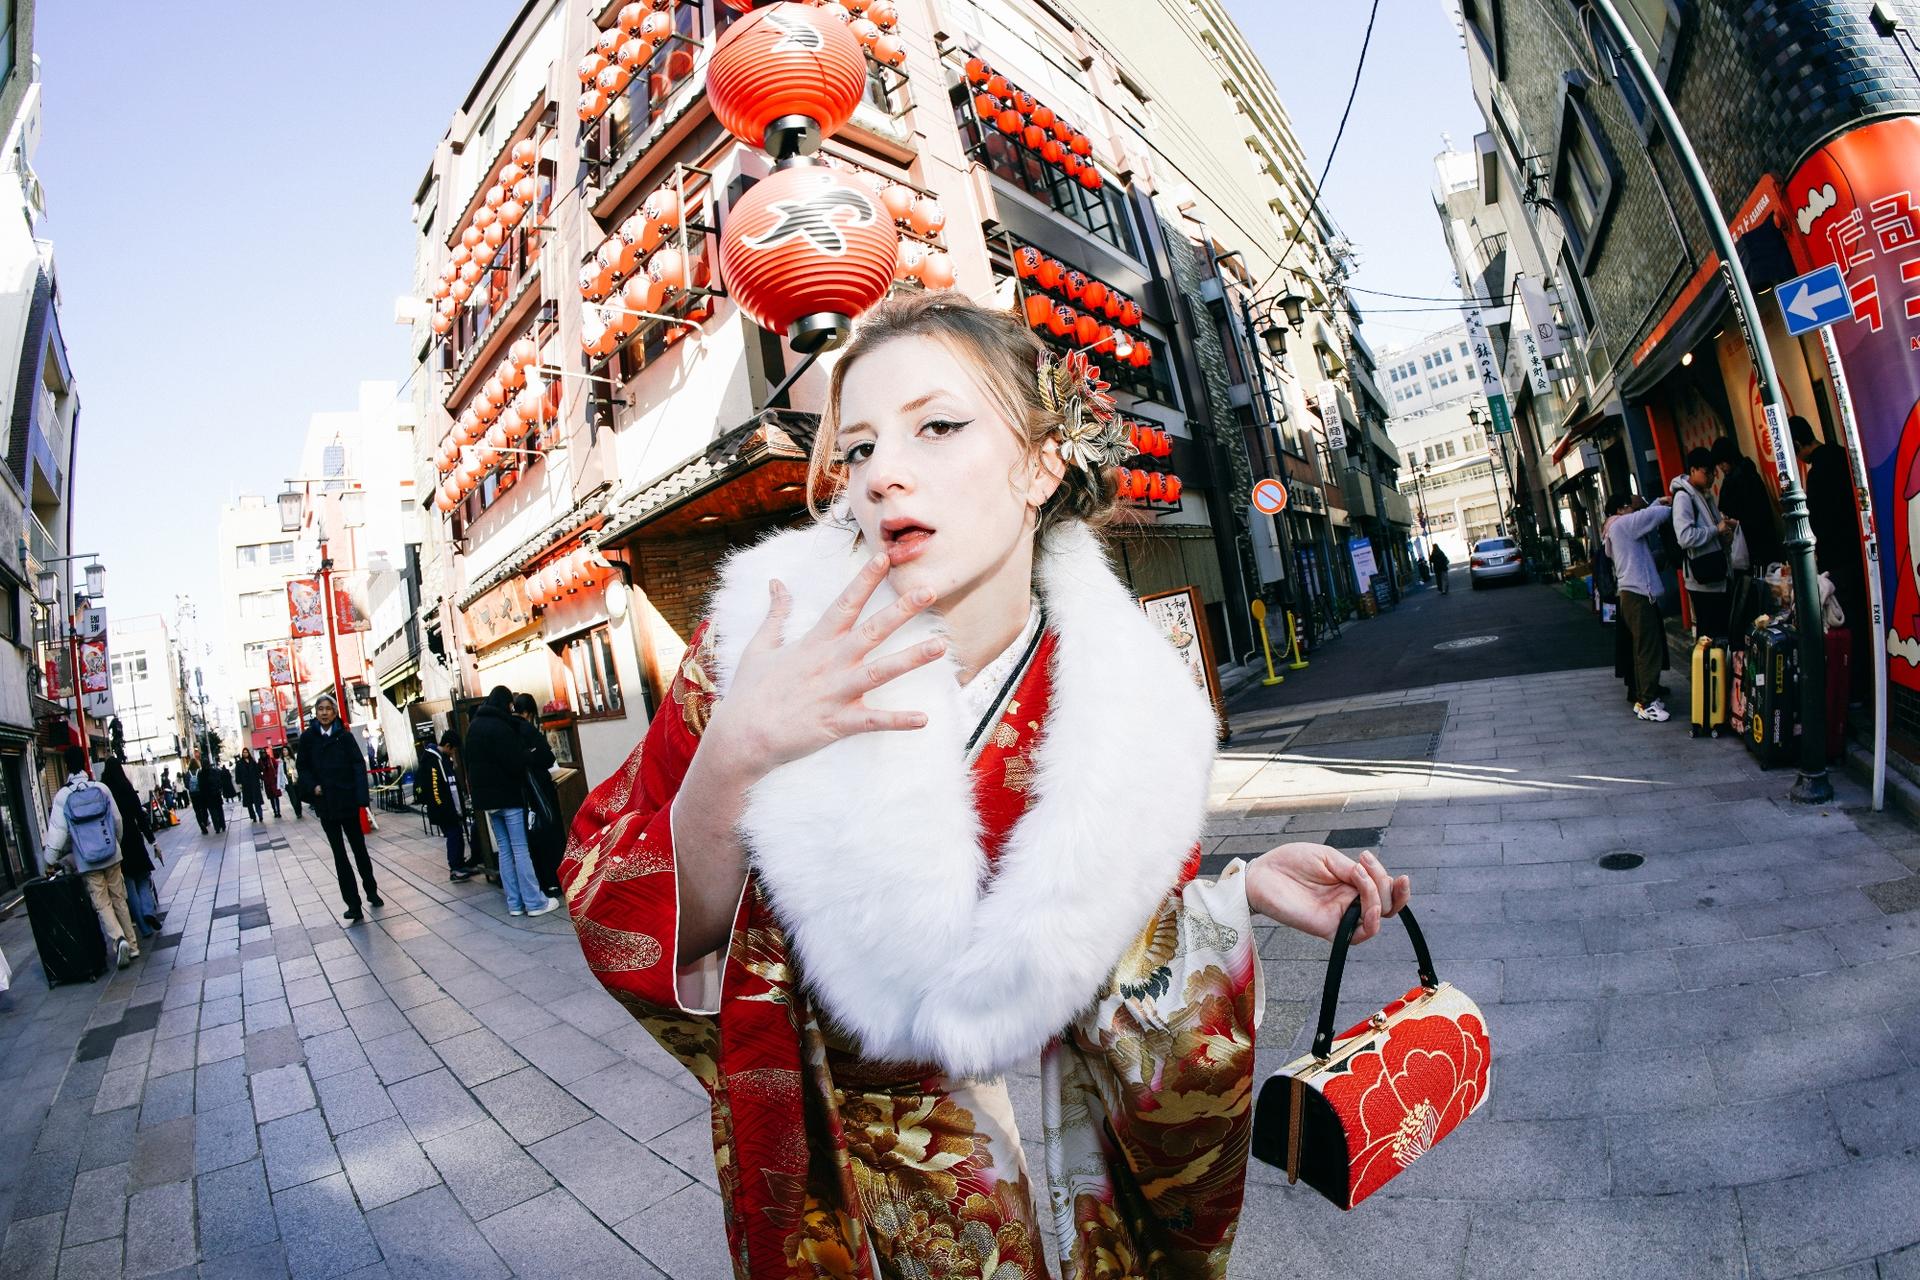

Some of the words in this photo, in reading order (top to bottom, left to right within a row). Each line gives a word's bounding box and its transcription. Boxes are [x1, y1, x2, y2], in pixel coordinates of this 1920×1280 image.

[1475, 342, 1498, 385] 鉢の木
[1523, 333, 1547, 390] 浅草東町会
[90, 614, 100, 633] 珈琲
